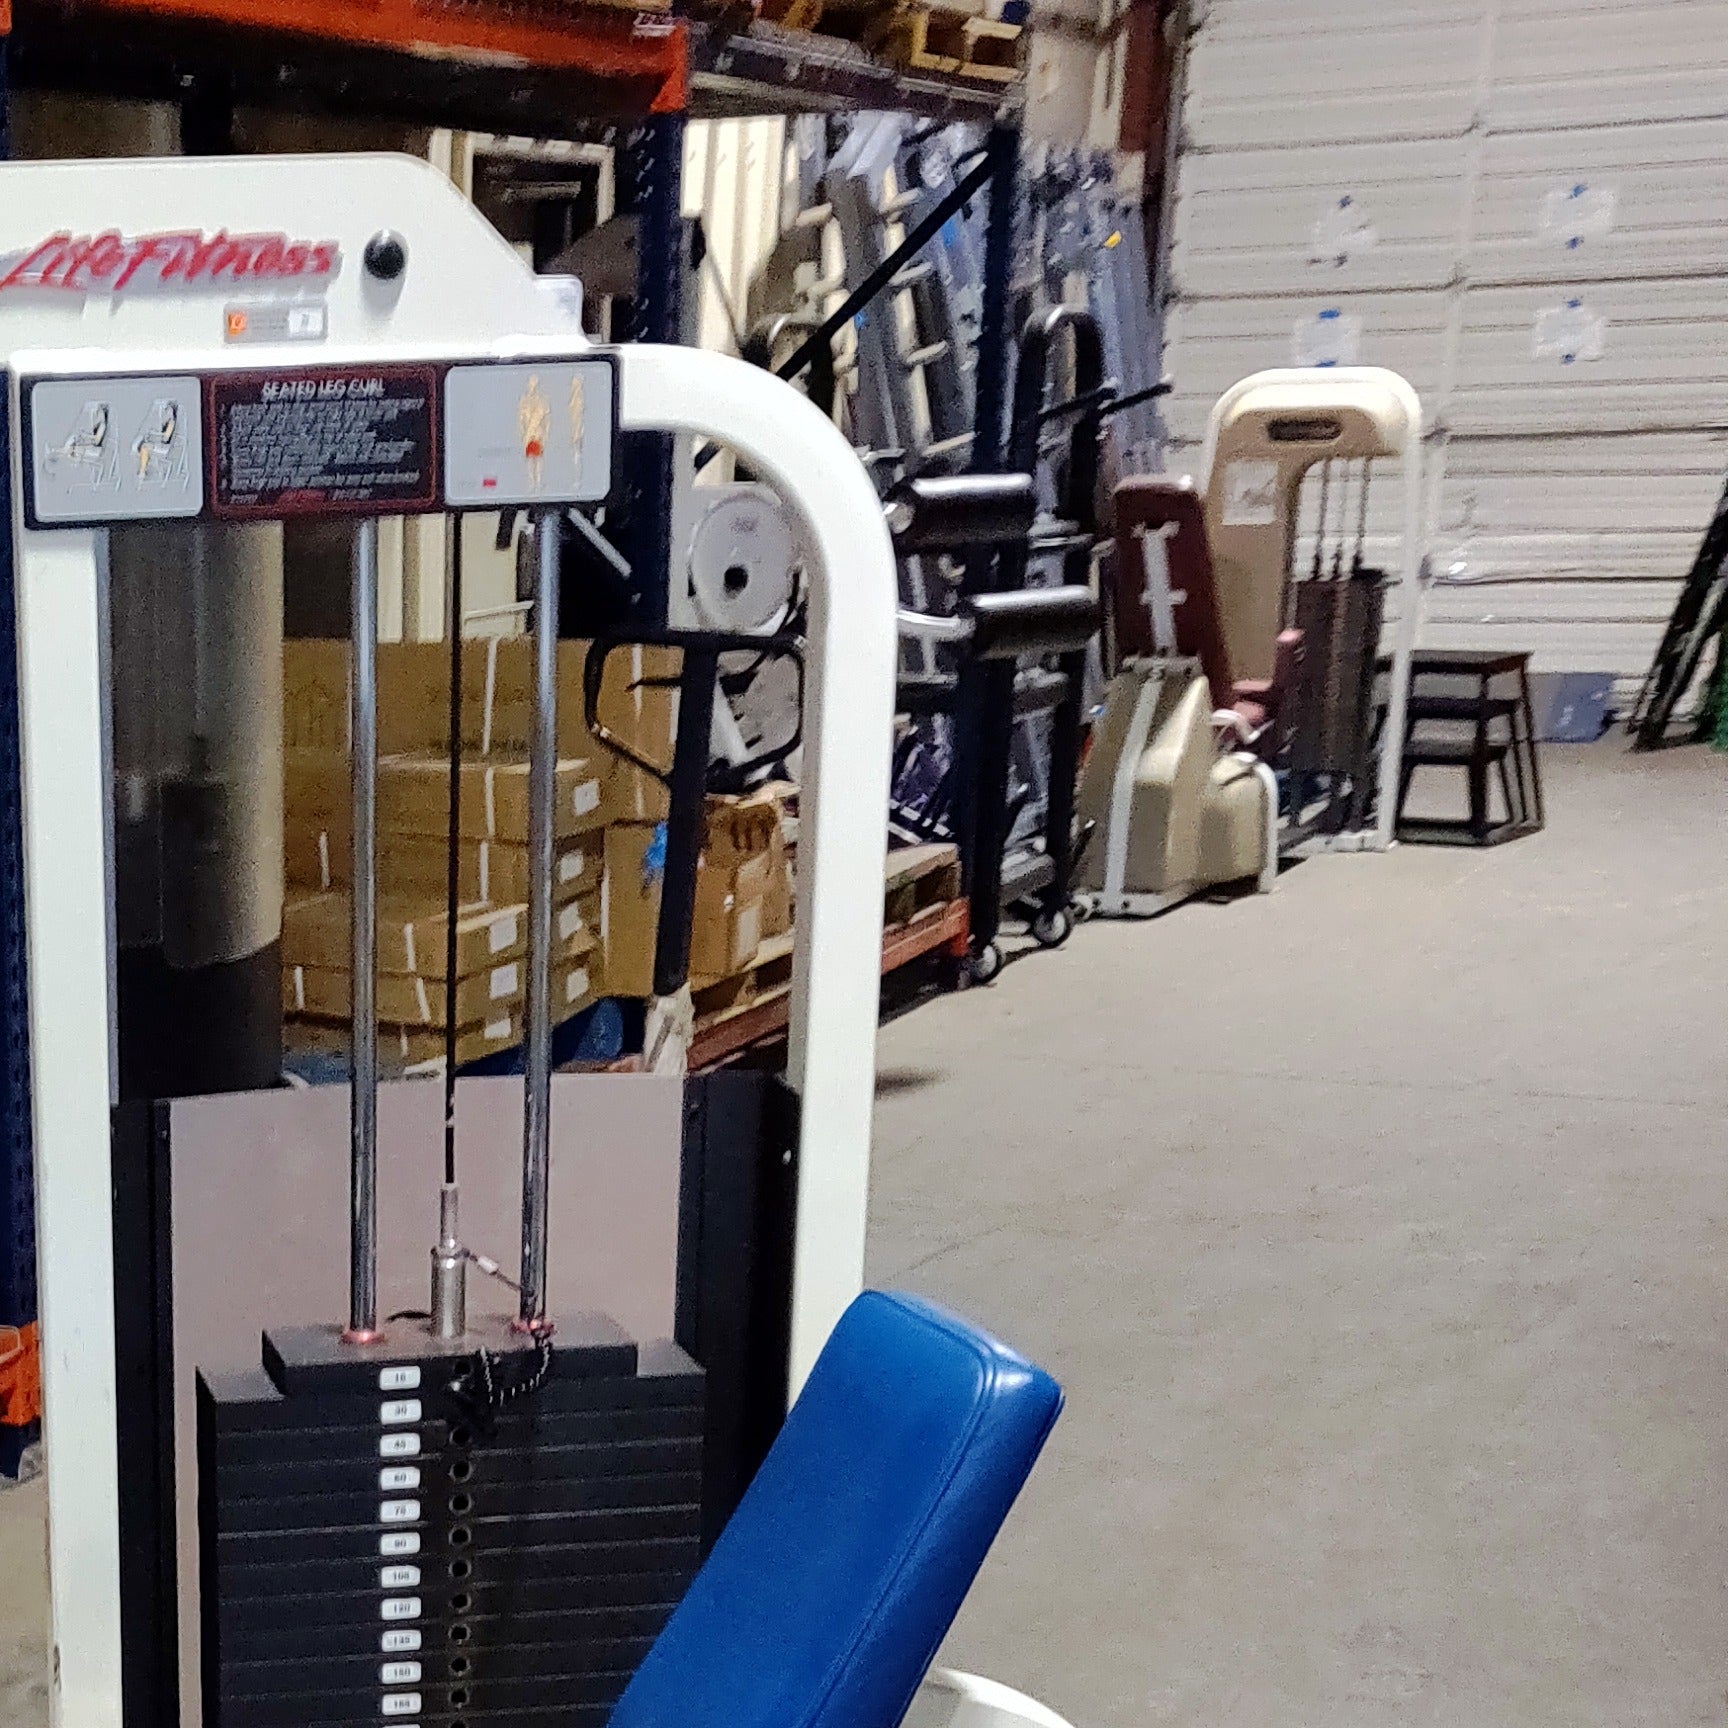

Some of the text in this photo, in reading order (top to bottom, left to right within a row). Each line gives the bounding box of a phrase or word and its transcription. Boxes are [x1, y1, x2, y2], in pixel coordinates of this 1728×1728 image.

[262, 378, 385, 399] SEATED LEG CURL
